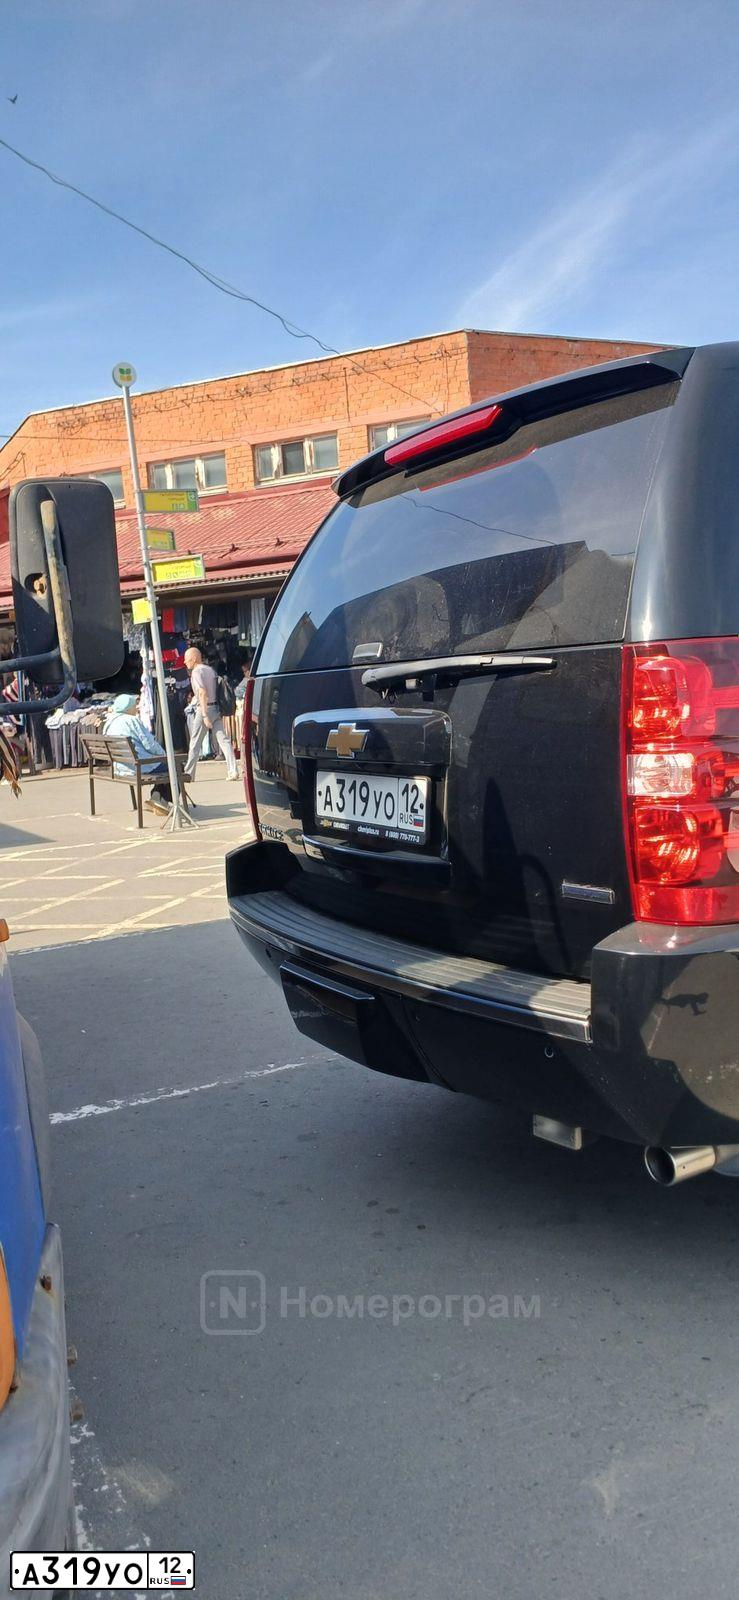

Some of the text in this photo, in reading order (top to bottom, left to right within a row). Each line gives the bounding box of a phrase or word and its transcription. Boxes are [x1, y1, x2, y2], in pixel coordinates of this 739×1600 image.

[324, 779, 418, 820] А319УО 12
[400, 813, 413, 824] RUS
